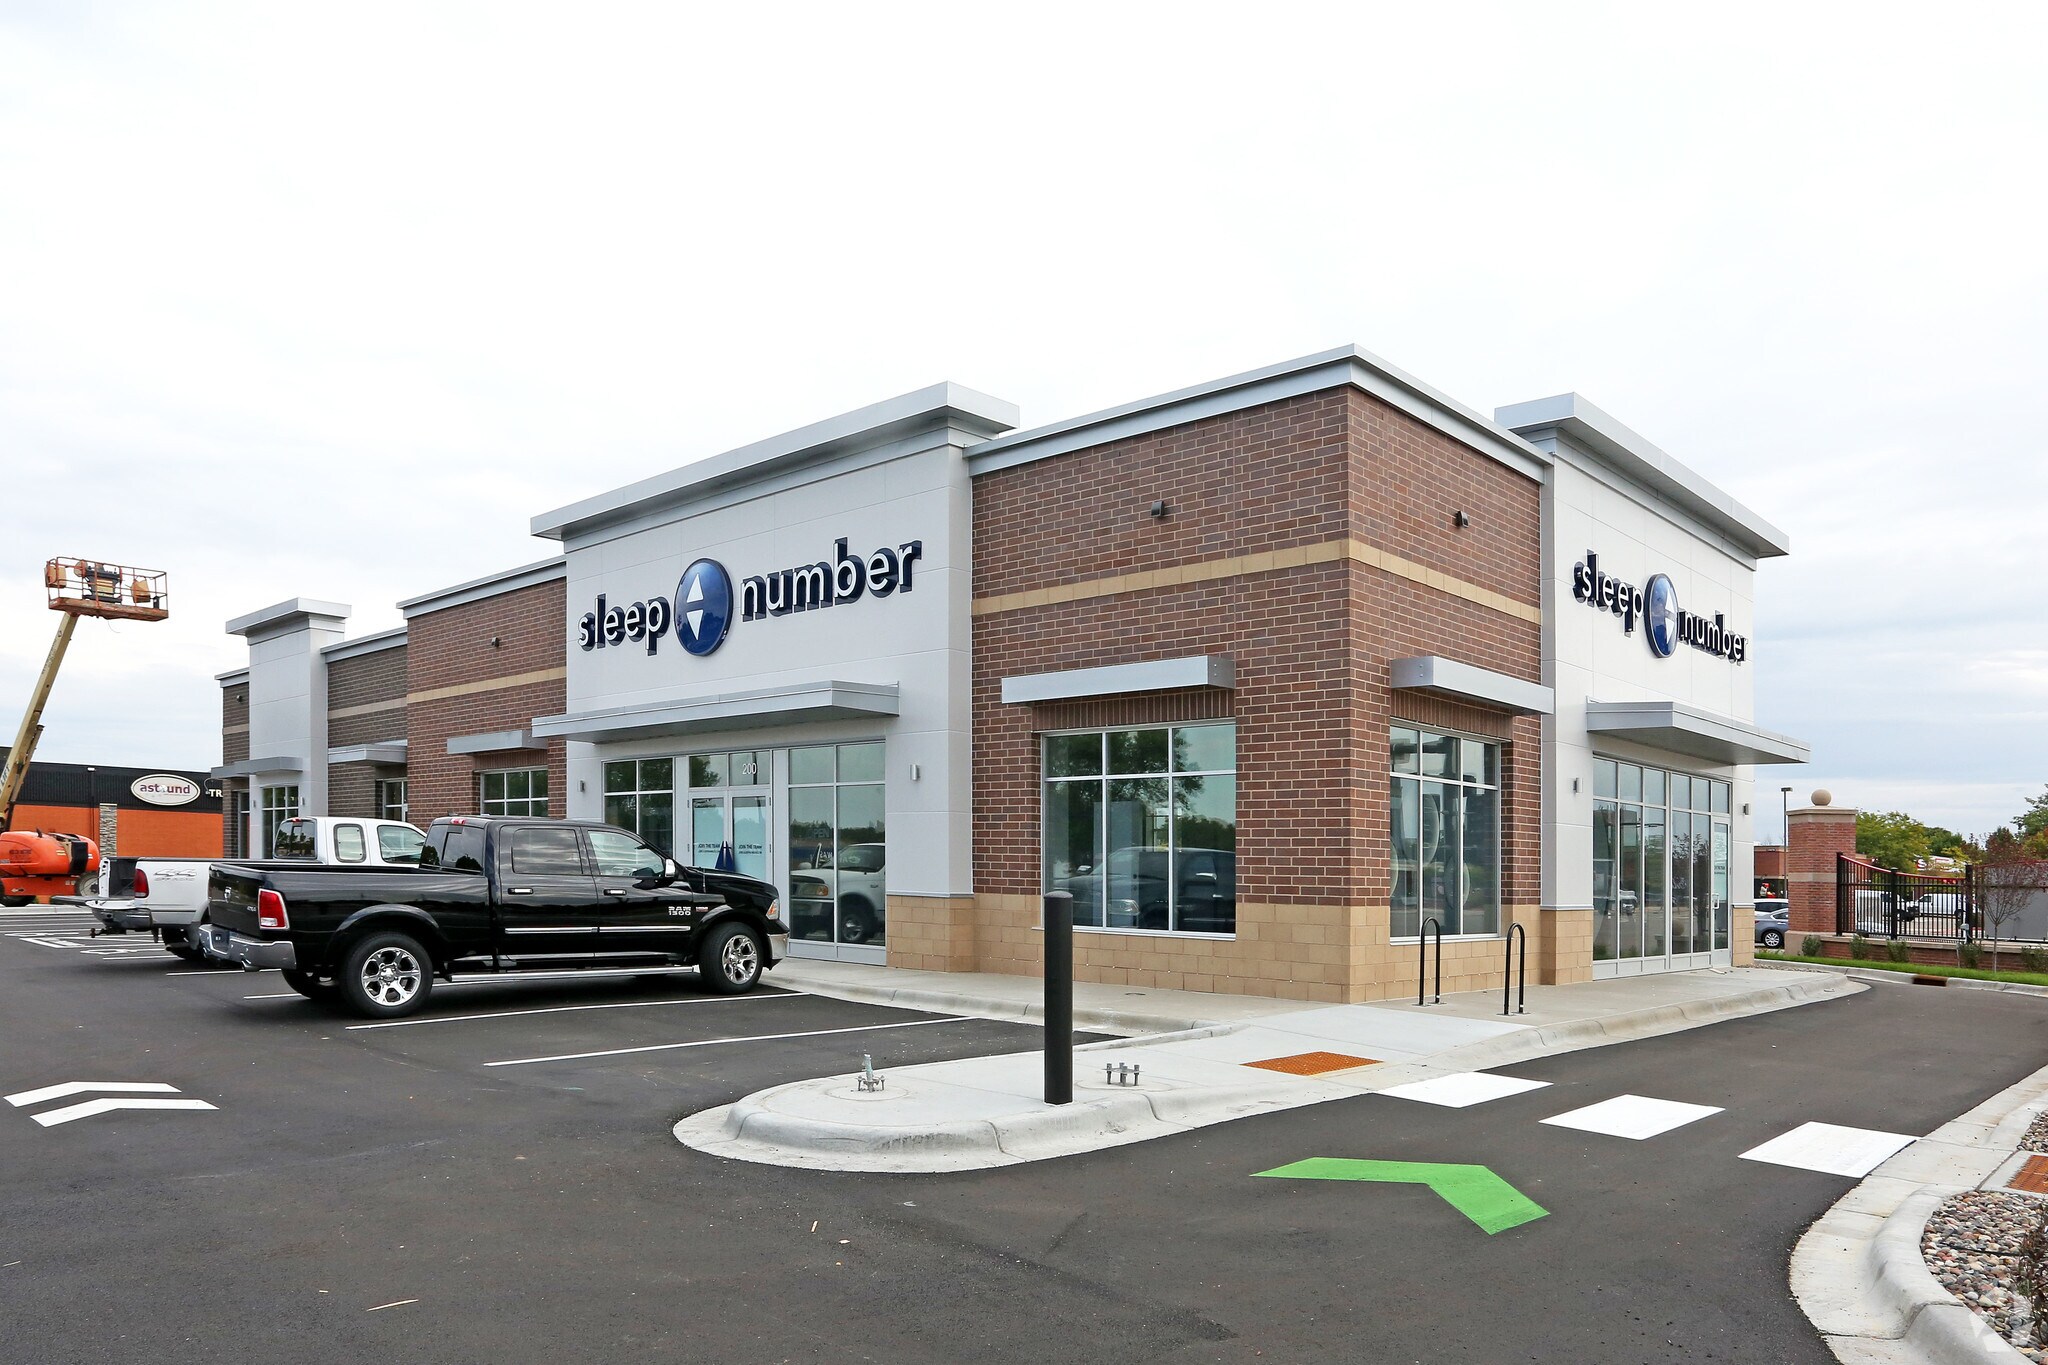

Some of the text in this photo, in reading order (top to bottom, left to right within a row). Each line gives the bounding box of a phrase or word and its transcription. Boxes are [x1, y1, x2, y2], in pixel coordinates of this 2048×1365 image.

[577, 536, 922, 656] sleep number
[1573, 549, 1748, 666] sleep number
[742, 763, 757, 775] 200
